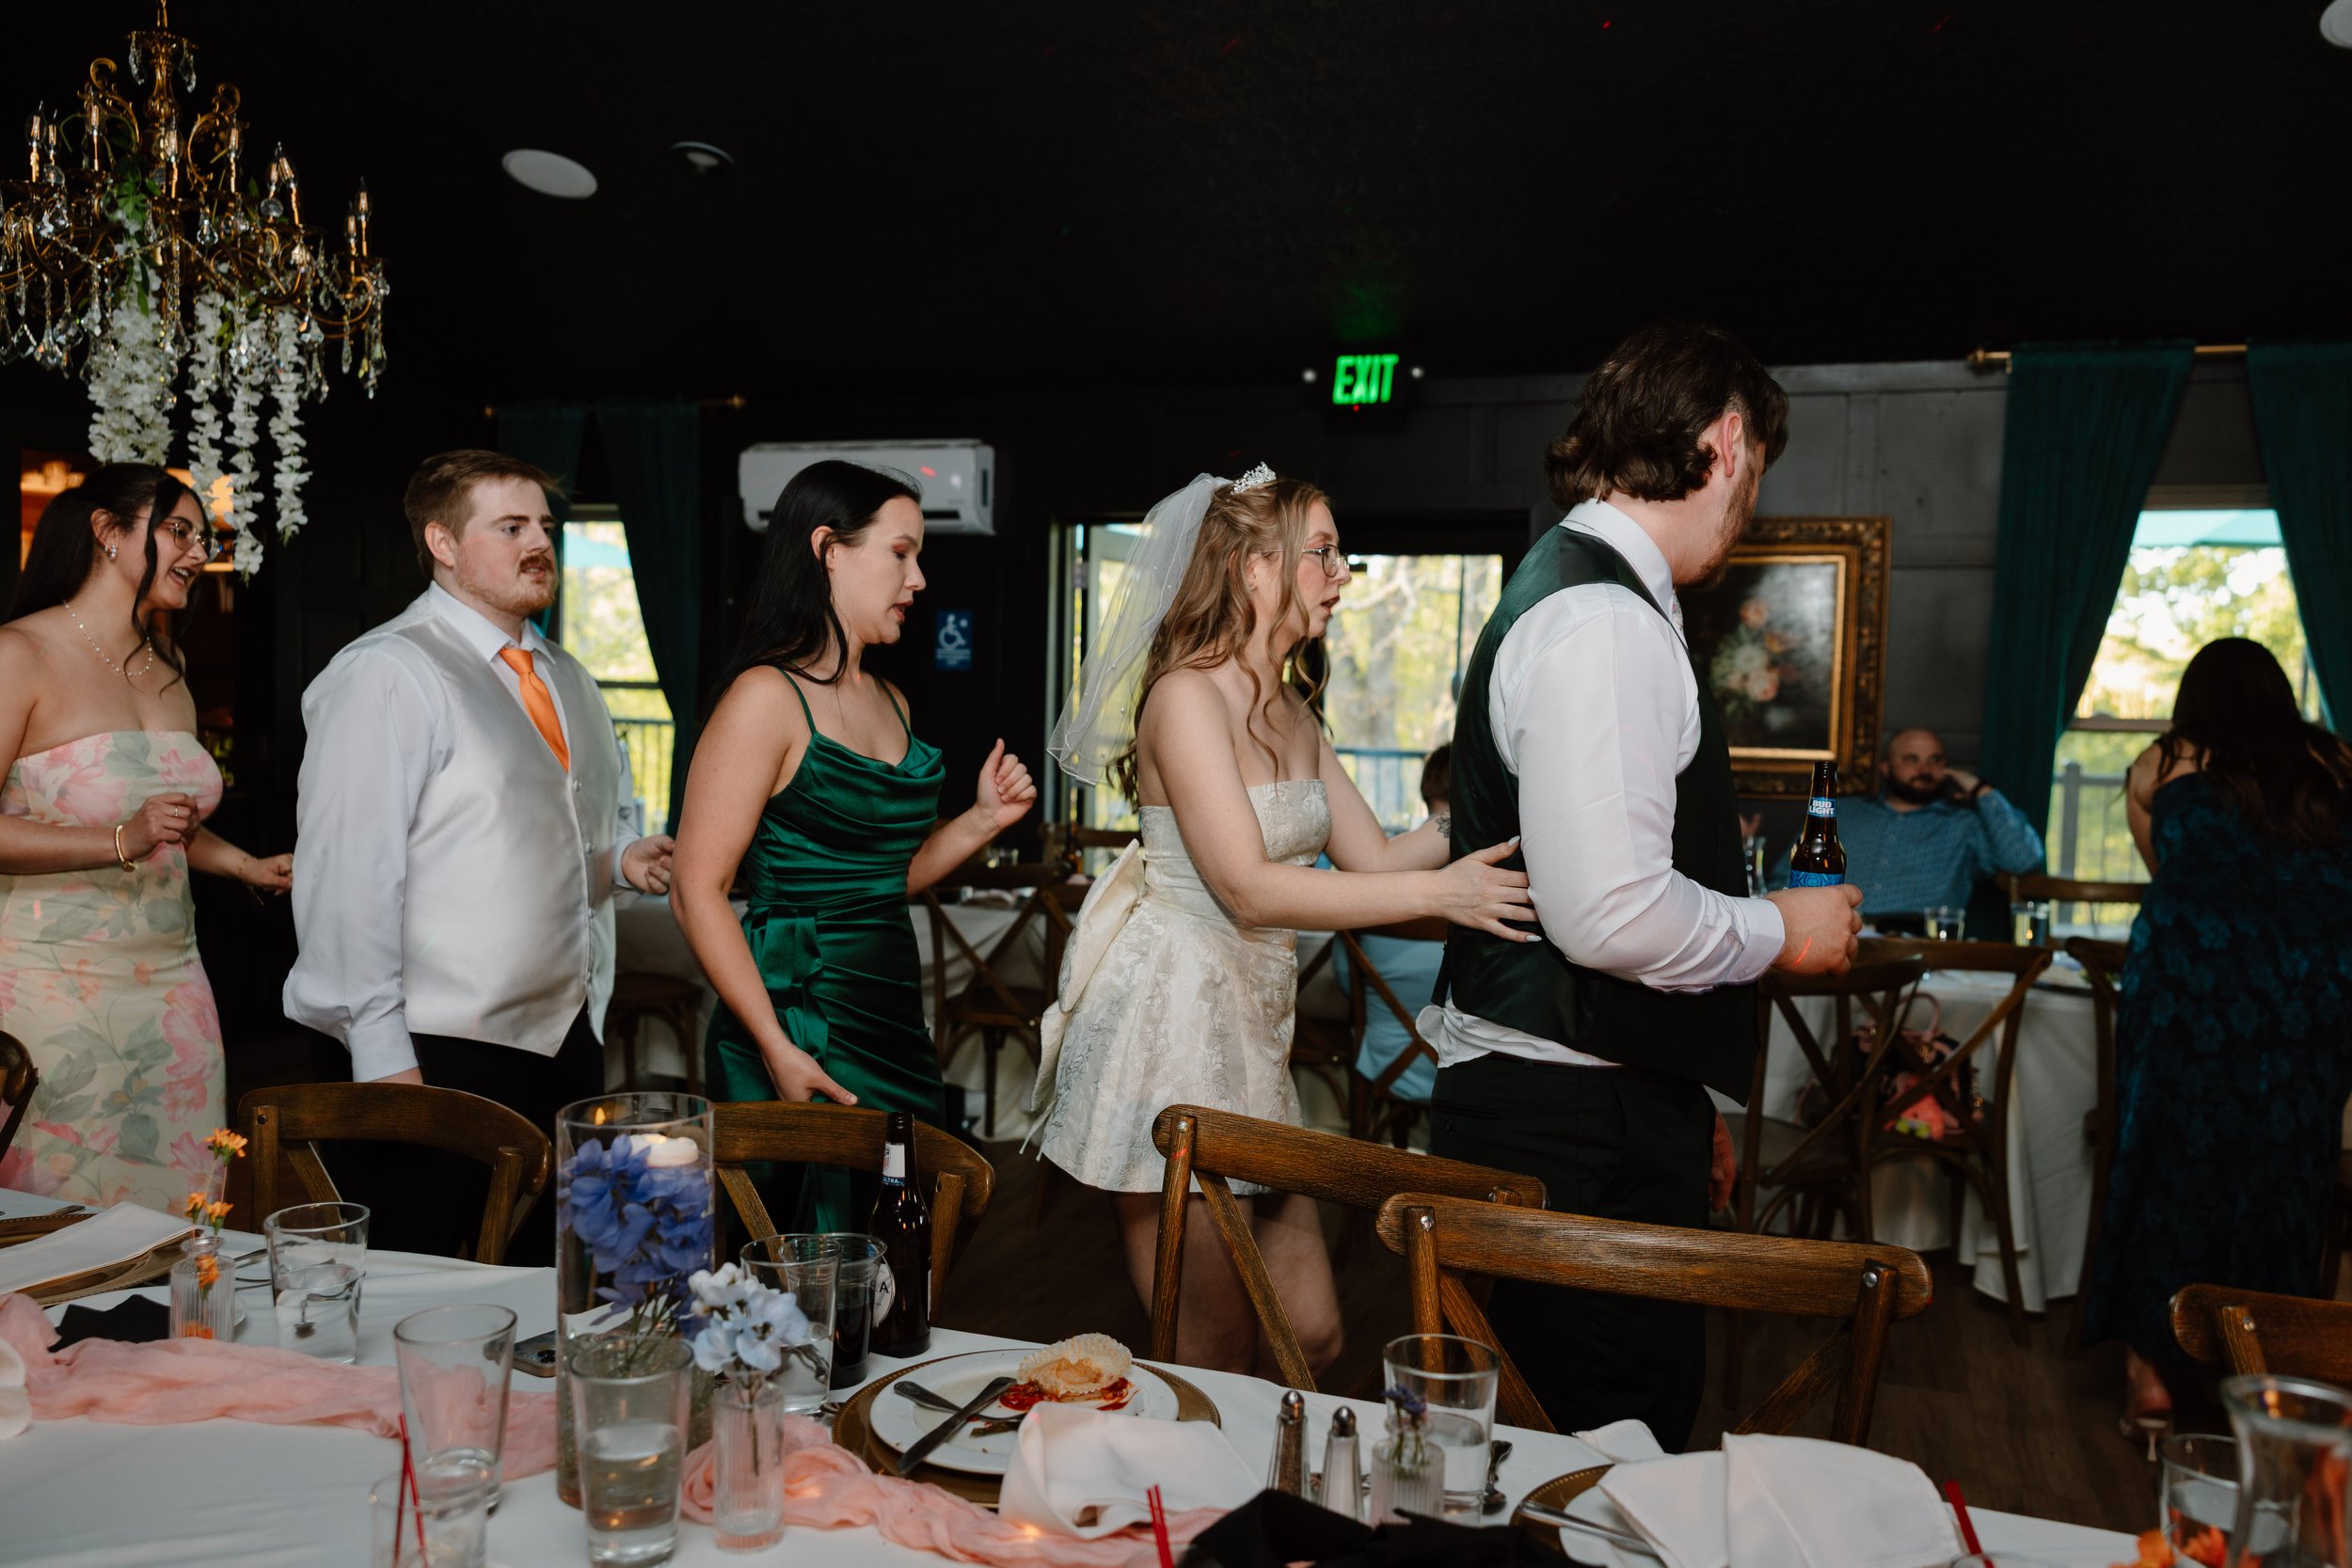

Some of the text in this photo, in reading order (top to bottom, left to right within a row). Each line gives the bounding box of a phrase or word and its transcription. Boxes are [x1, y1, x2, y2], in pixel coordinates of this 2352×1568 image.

[1333, 355, 1399, 404] EXIT
[1812, 800, 1833, 808] BUD
[1808, 805, 1835, 816] LIGHT
